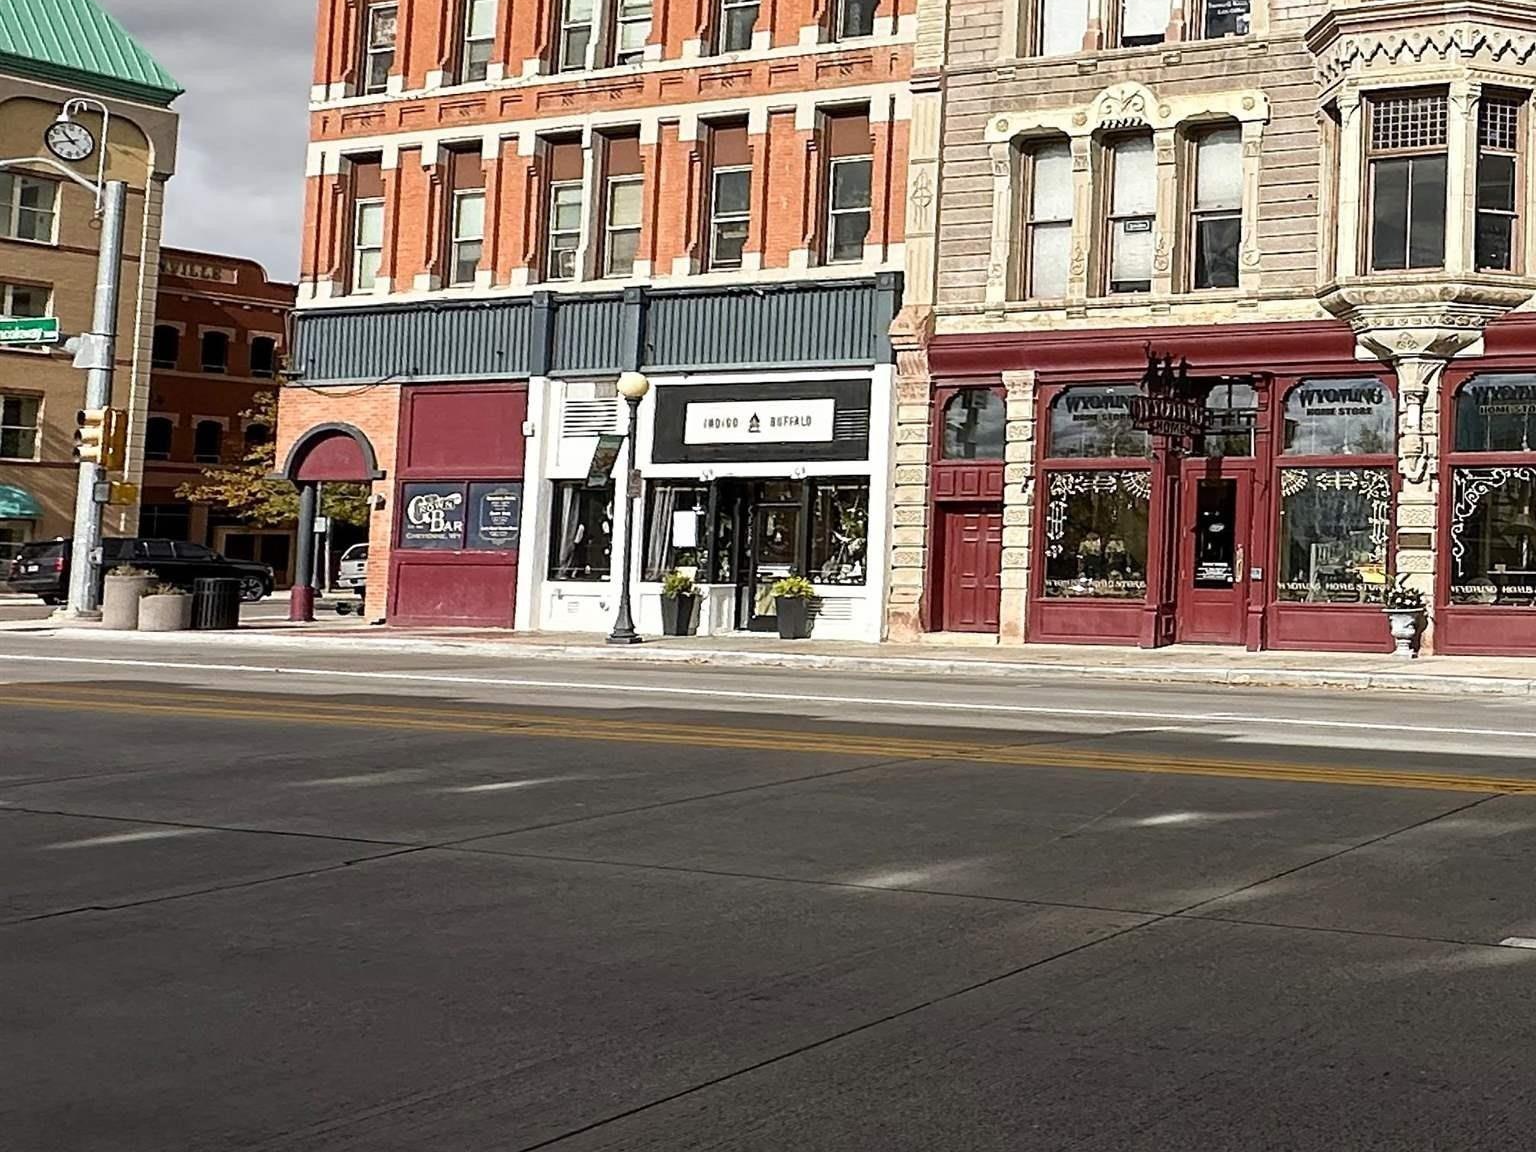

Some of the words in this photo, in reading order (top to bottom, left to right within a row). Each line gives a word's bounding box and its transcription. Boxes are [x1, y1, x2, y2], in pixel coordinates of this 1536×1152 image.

[1065, 395, 1133, 413] WYOMIN
[1300, 388, 1384, 407] WYOMING
[1338, 407, 1372, 415] STORE
[703, 418, 739, 429] INDIGO
[770, 415, 812, 428] BUFFALO
[430, 510, 463, 533] BAR
